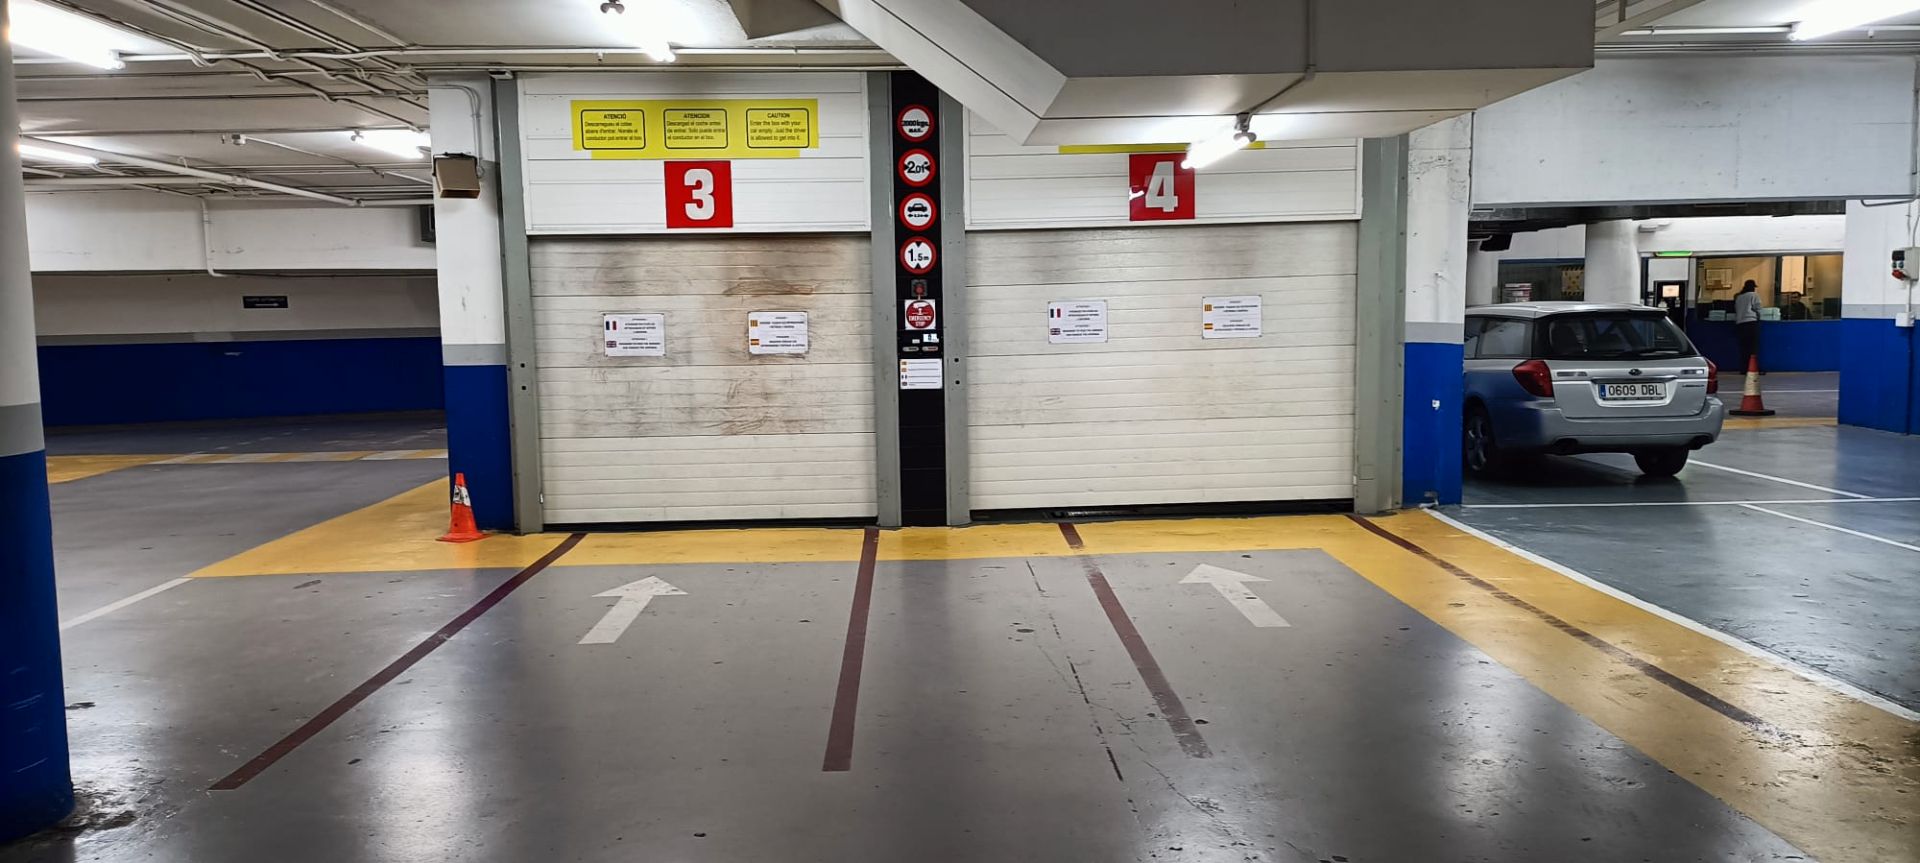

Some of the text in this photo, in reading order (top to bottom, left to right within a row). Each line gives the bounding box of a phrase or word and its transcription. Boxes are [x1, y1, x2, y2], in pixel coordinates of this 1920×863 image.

[683, 168, 715, 221] 3
[1145, 161, 1179, 213] 4
[1608, 384, 1662, 396] 0609 DBL
